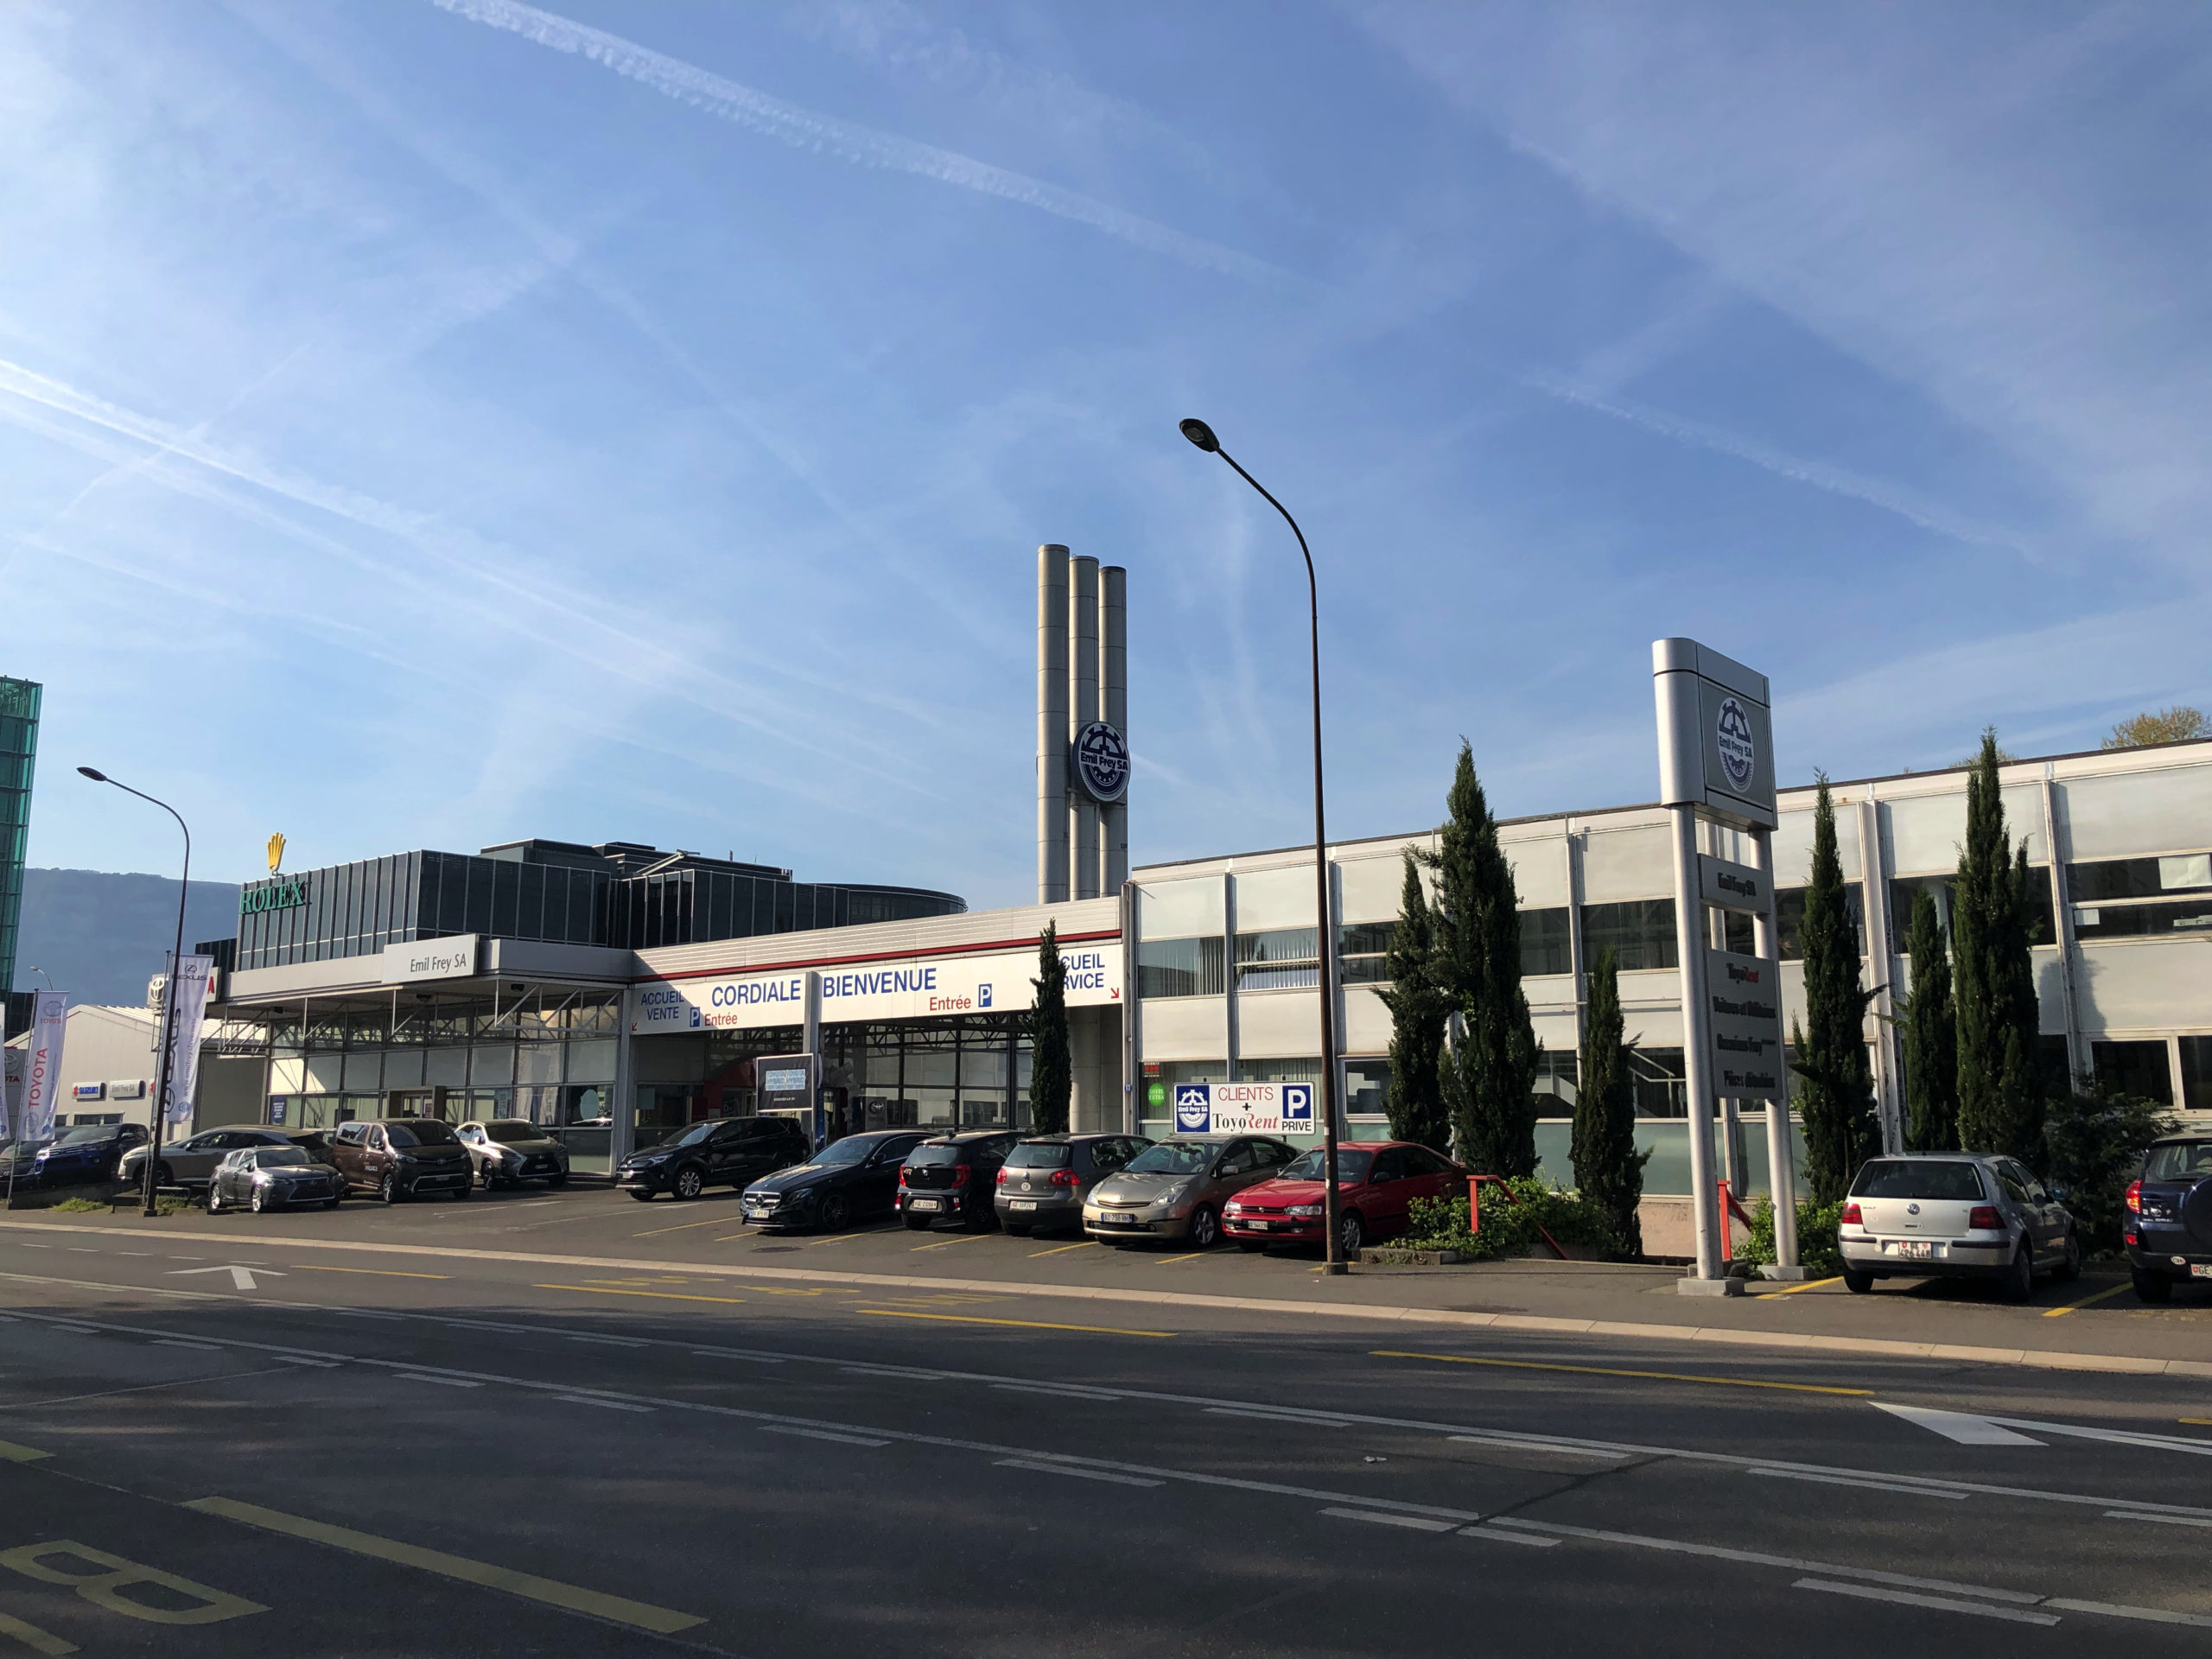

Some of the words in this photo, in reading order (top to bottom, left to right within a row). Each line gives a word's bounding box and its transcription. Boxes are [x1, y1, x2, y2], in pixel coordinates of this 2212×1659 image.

[1719, 735, 1731, 751] Emil
[1731, 741, 1744, 757] Frey
[1745, 746, 1753, 759] SA
[1080, 752, 1098, 766] Emil
[1099, 755, 1116, 770] Frey
[1116, 760, 1128, 771] SA
[239, 881, 304, 914] ROLEX
[410, 956, 429, 973] Emil
[432, 955, 452, 974] Frey
[454, 952, 467, 969] SA
[1060, 953, 1105, 972] CUEIL
[712, 979, 801, 1007] CORDIALE
[823, 967, 937, 999] BIENVENUE
[1064, 972, 1105, 990] RVICE
[640, 990, 684, 1006] ACCUEIL
[929, 995, 971, 1012] Entrée
[981, 985, 991, 1007] P
[647, 1006, 679, 1020] VENTE
[691, 1008, 700, 1027] P
[704, 1012, 738, 1027] Entrée
[29, 1047, 48, 1109] TOYOTA
[1217, 1086, 1274, 1102] CLIENTS
[1287, 1089, 1307, 1118] P
[1212, 1112, 1278, 1134] ToyoRent
[1281, 1121, 1312, 1131] PRIVE
